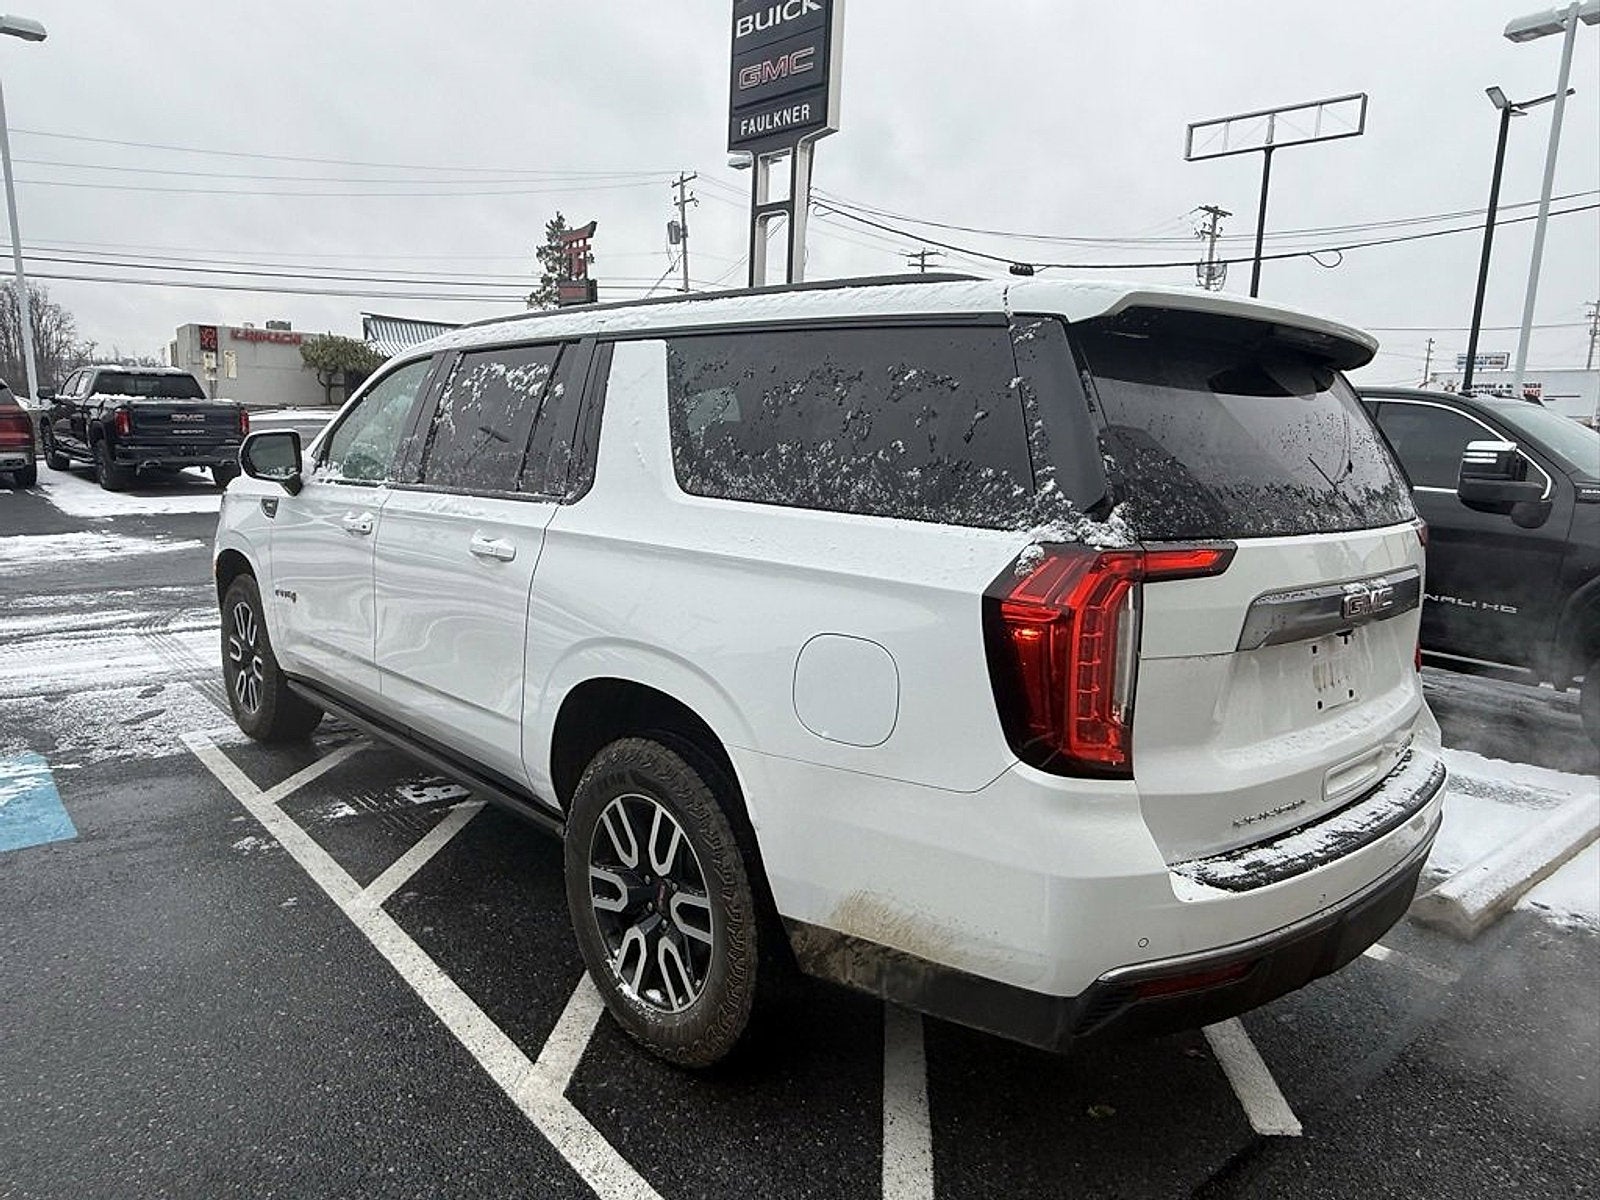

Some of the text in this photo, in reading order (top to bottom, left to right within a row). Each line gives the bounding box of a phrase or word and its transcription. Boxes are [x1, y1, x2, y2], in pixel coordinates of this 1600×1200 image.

[736, 0, 822, 38] BUICK
[739, 46, 815, 90] GMC
[740, 104, 811, 136] FAULKNER
[1344, 587, 1393, 619] GMC
[1424, 593, 1476, 608] NALI
